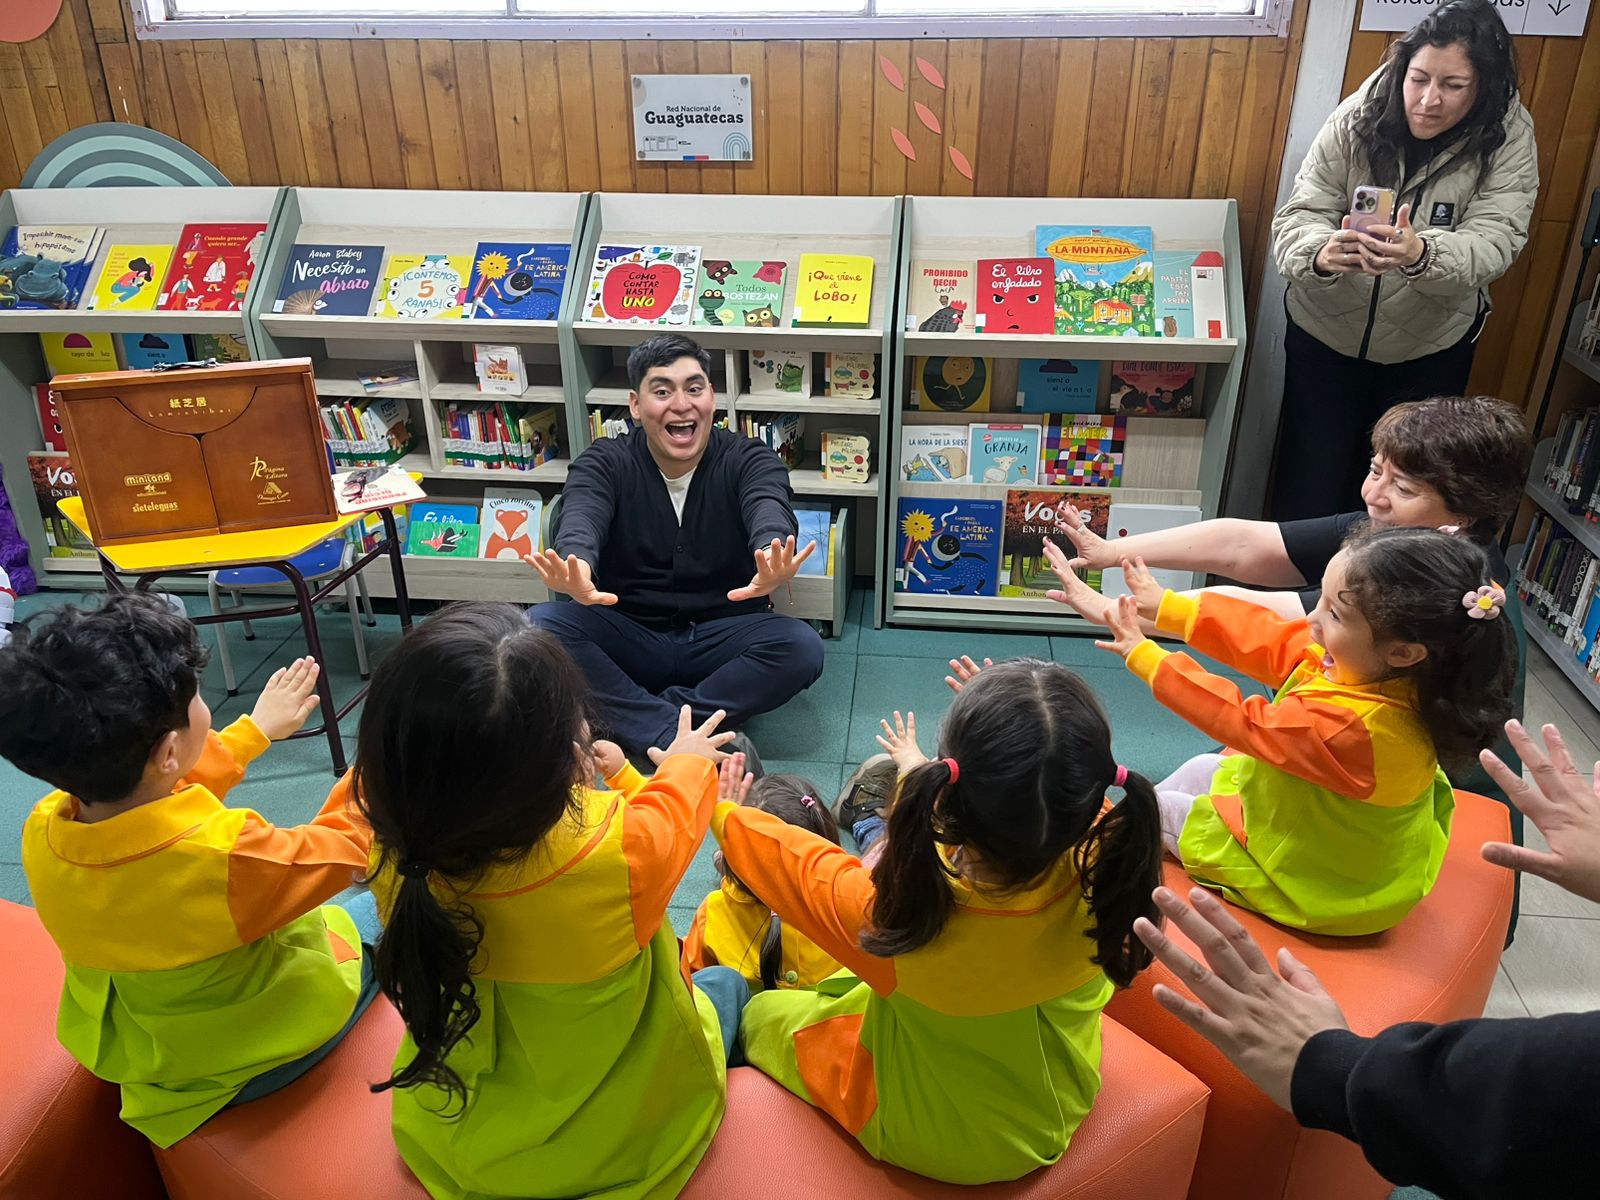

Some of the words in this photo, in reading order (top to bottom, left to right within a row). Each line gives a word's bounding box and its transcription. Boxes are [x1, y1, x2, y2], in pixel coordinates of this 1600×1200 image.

[645, 111, 744, 128] Guaguatecas
[309, 249, 331, 258] Aaron
[336, 248, 363, 262] Blabey
[1055, 245, 1069, 254] LA
[292, 259, 354, 284] Necesito
[404, 271, 458, 282] ¡CONTEMOS
[629, 272, 657, 280] COMO
[923, 268, 968, 278] PROHIBIDO
[992, 264, 1007, 278] El
[1014, 264, 1042, 277] libro
[836, 272, 862, 282] viene
[933, 278, 958, 287] DECIR
[320, 276, 370, 294] abrazo
[418, 280, 434, 298] 5
[624, 280, 660, 288] CONTAR
[736, 284, 767, 293] Todos
[992, 276, 1042, 294] enfadado
[626, 288, 654, 296] HASTA
[722, 292, 779, 301] BOSTEZAN
[814, 290, 857, 304] LOBO!
[402, 298, 443, 309] RANAS!
[622, 295, 656, 308] UNO
[1061, 426, 1109, 439] ELMER
[917, 439, 934, 447] HORA
[952, 438, 968, 447] SIEST
[984, 441, 1028, 456] GRANJA
[490, 498, 510, 510] Cinco
[510, 498, 536, 512] zorritos
[1022, 526, 1036, 534] EN
[1038, 526, 1050, 534] EL
[960, 533, 988, 541] LATINA
